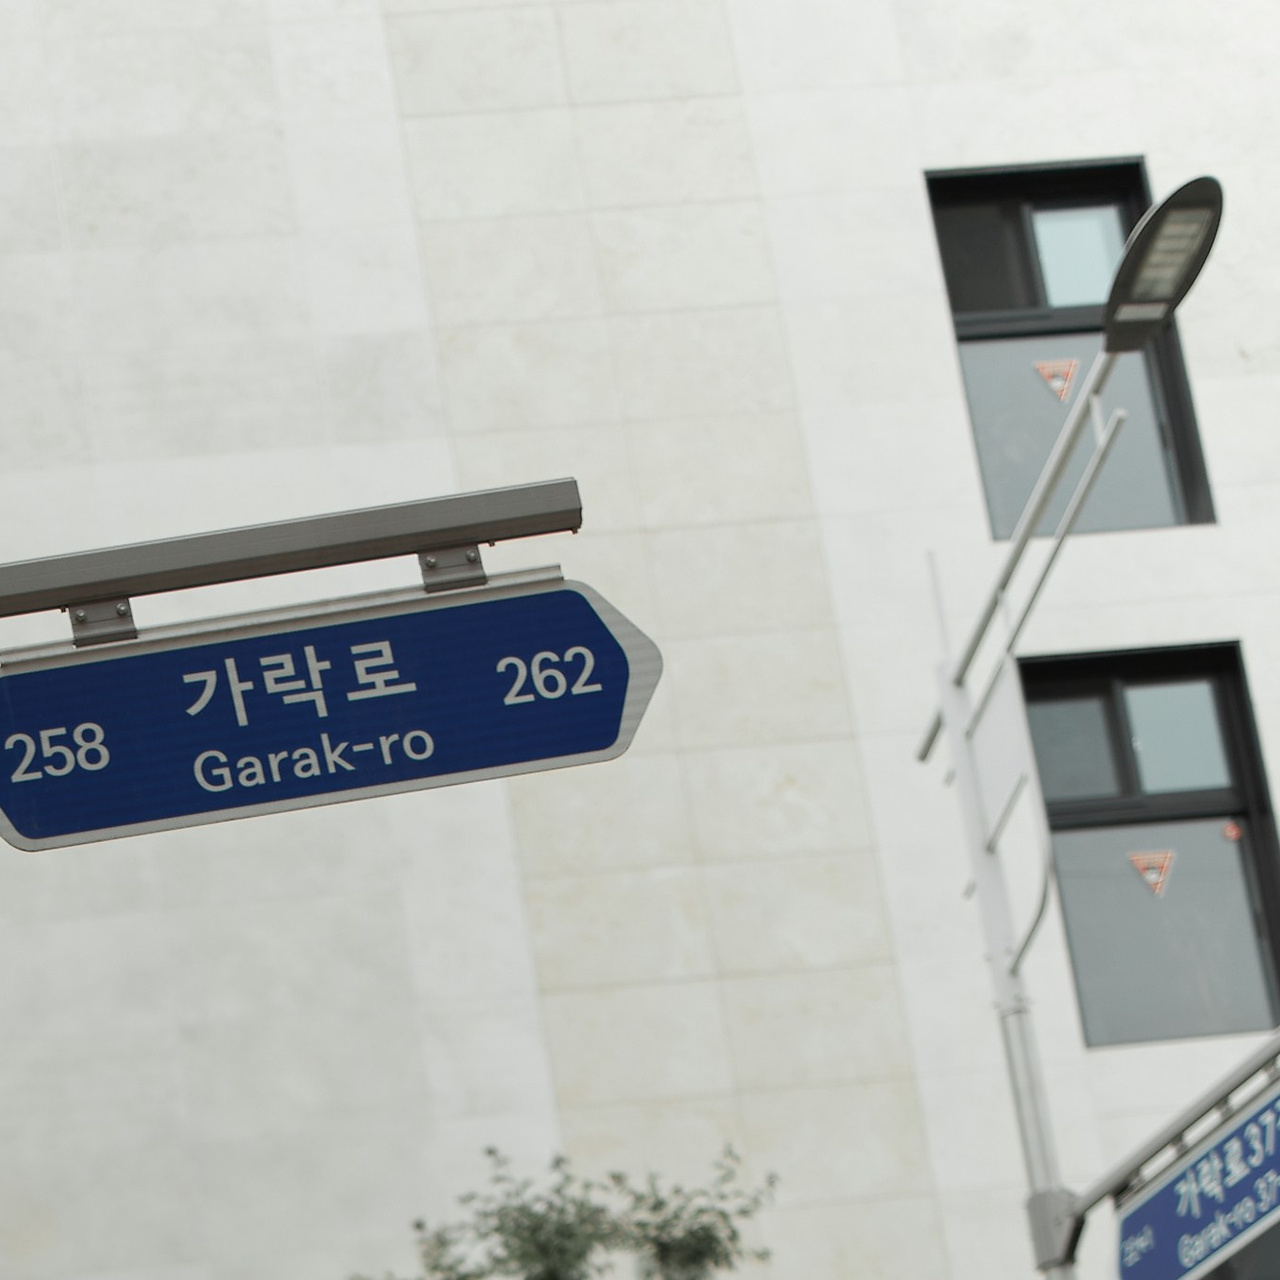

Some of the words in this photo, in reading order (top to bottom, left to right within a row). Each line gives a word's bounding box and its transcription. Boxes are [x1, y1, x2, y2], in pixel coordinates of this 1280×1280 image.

[182, 640, 417, 727] 가락로
[496, 645, 603, 706] 262
[3, 722, 110, 783] 258
[193, 729, 435, 793] Garak-ro
[1174, 1098, 1280, 1219] 가락로37
